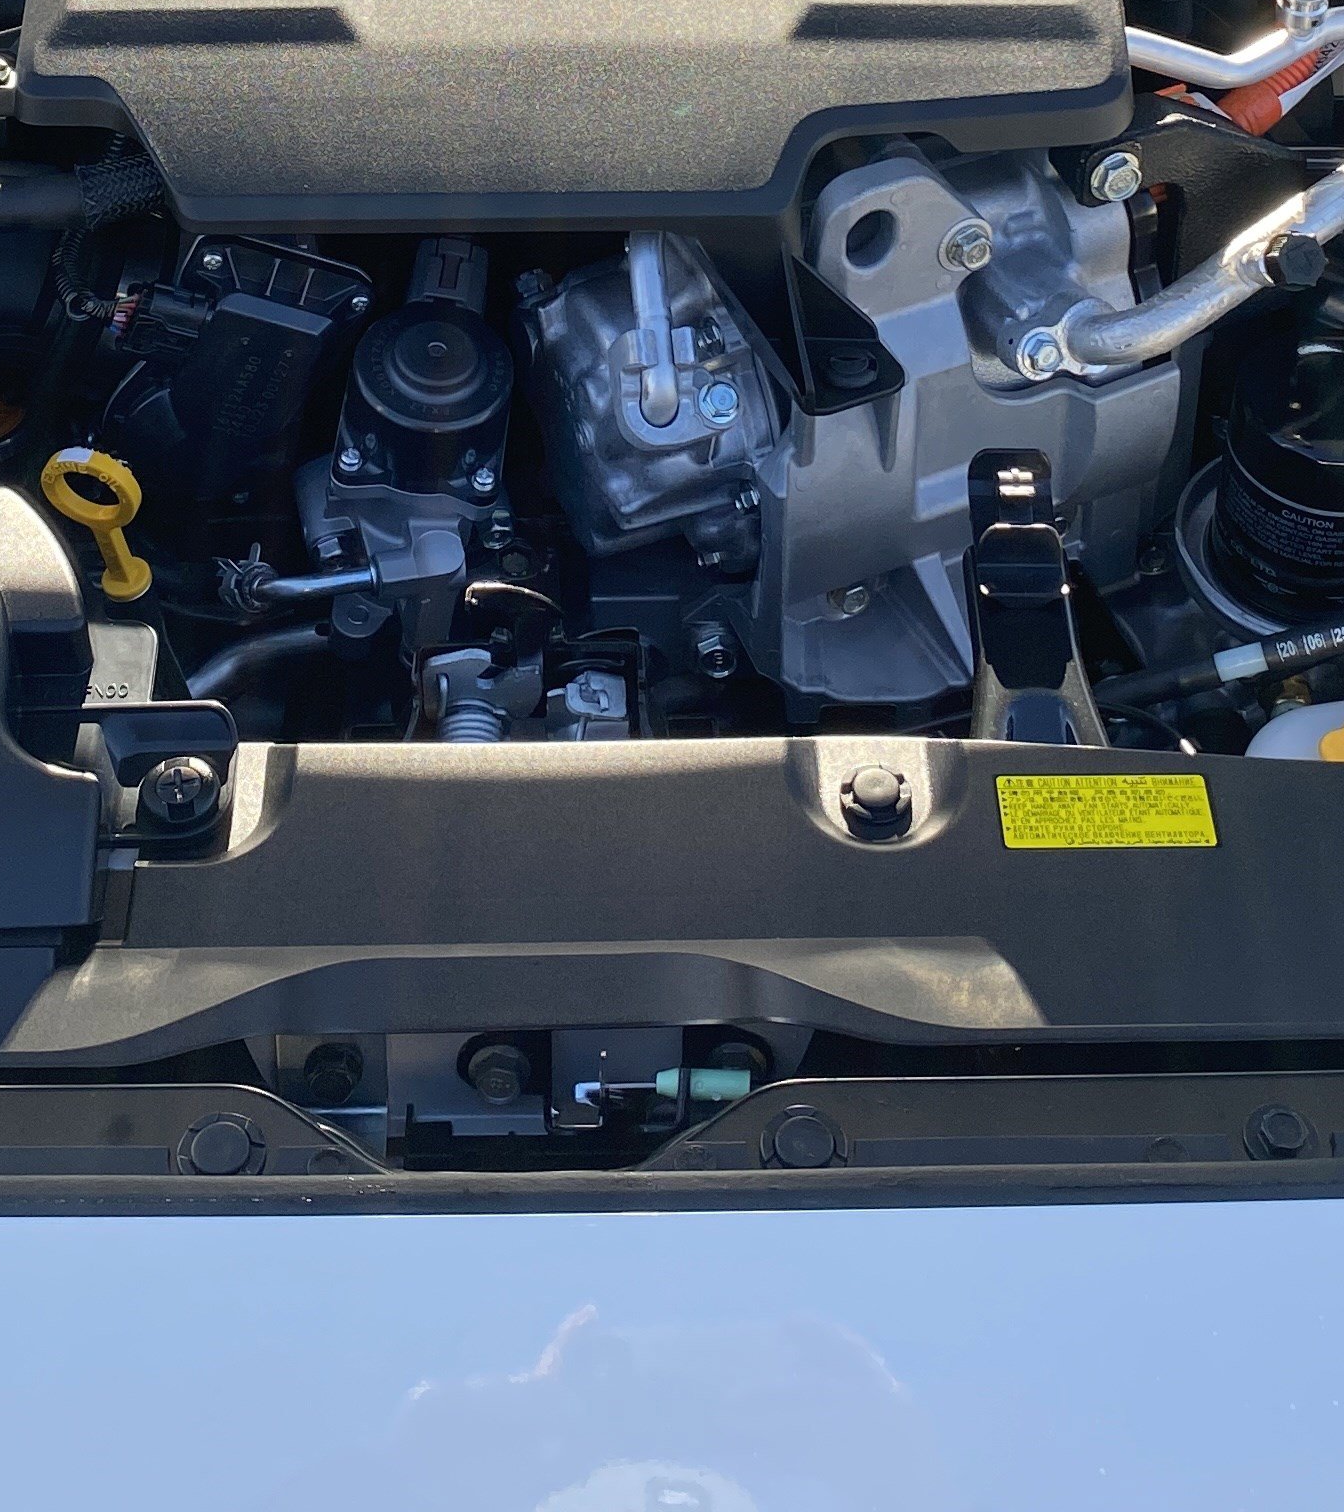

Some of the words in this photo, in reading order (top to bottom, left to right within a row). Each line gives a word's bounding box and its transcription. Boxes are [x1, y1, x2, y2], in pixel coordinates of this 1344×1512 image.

[1281, 509, 1335, 530] CAUTION
[1037, 777, 1071, 787] CAUTION
[1075, 776, 1118, 787] ATTENTION
[1151, 777, 1195, 786] ВНИМАНИЕ
